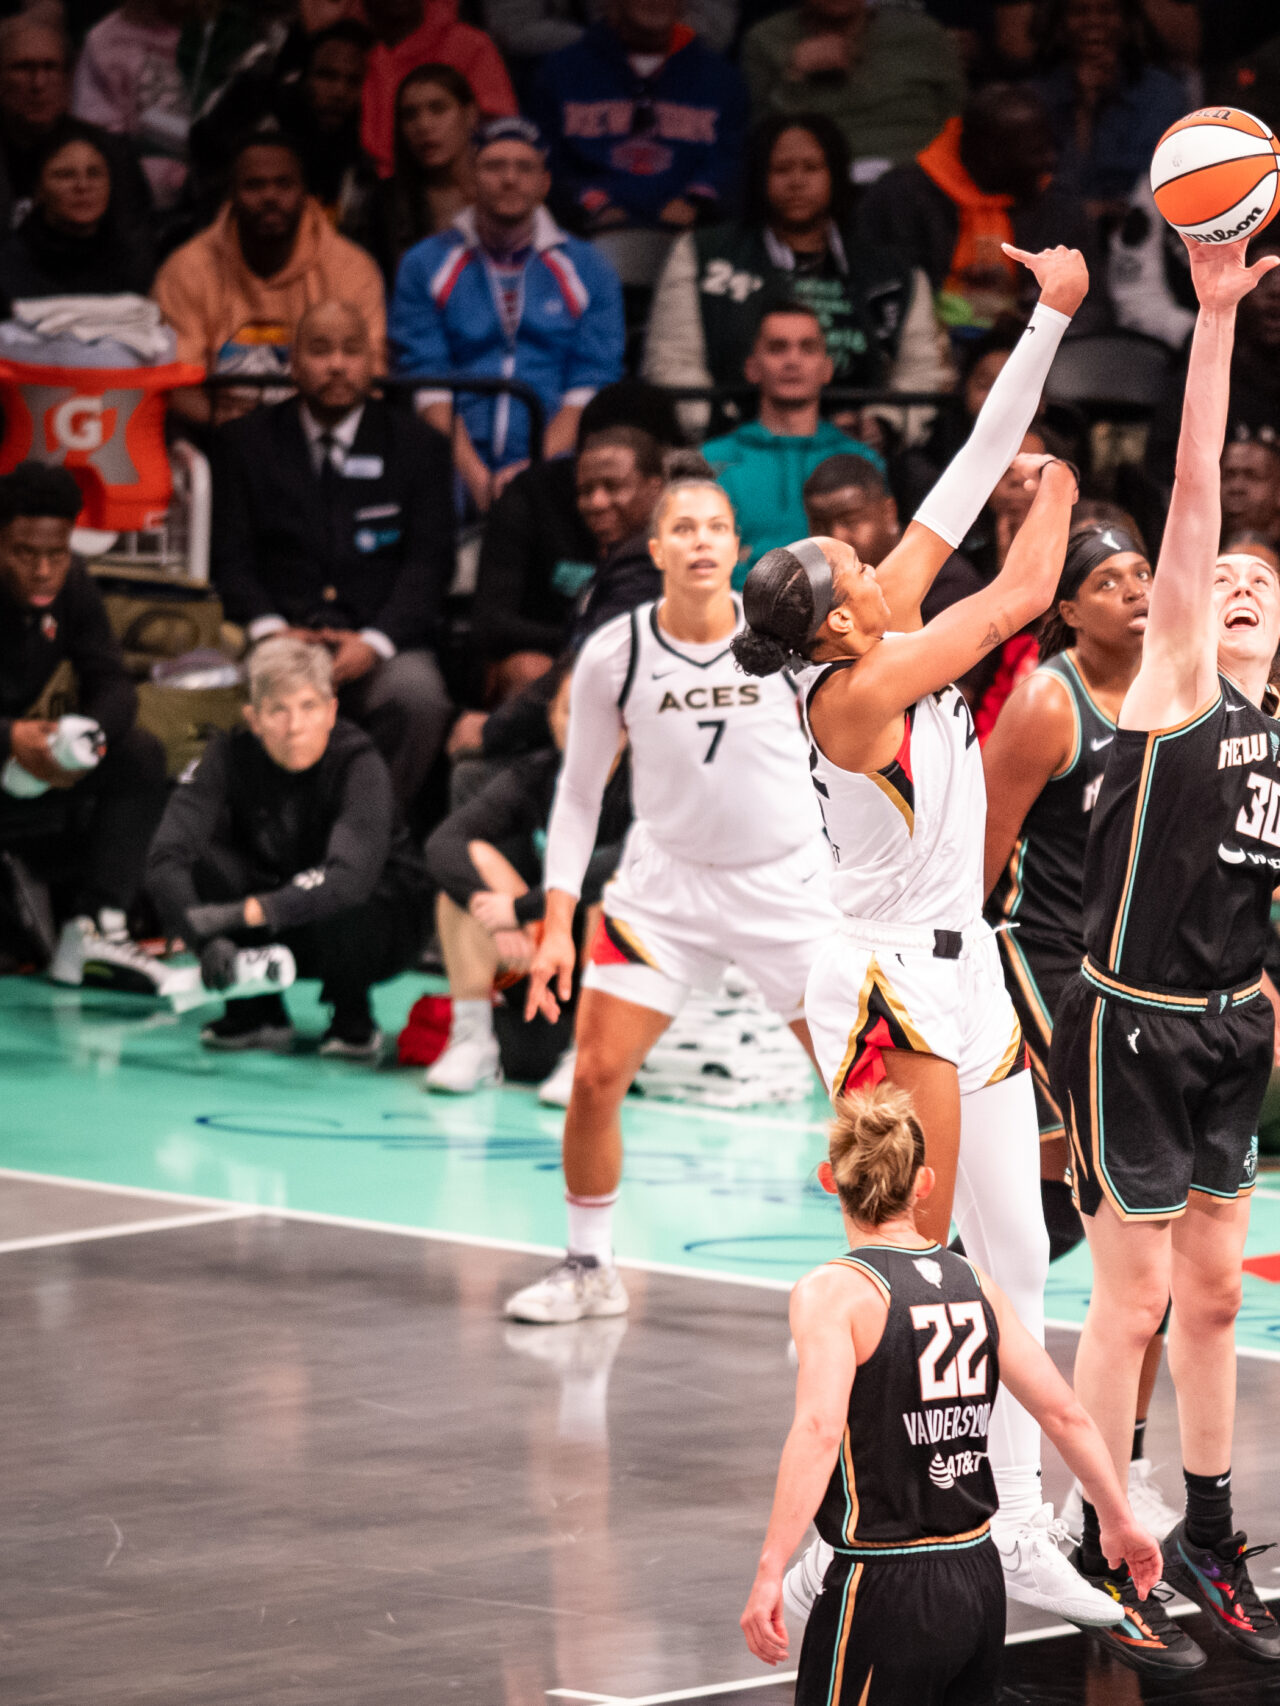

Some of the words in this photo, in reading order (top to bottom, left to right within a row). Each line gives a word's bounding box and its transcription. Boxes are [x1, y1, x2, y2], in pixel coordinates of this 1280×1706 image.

[53, 396, 102, 450] G
[658, 683, 761, 714] ACES
[697, 718, 727, 764] 7
[1218, 732, 1268, 770] NEW
[909, 1301, 989, 1401] 22
[946, 1451, 990, 1478] AT&T
